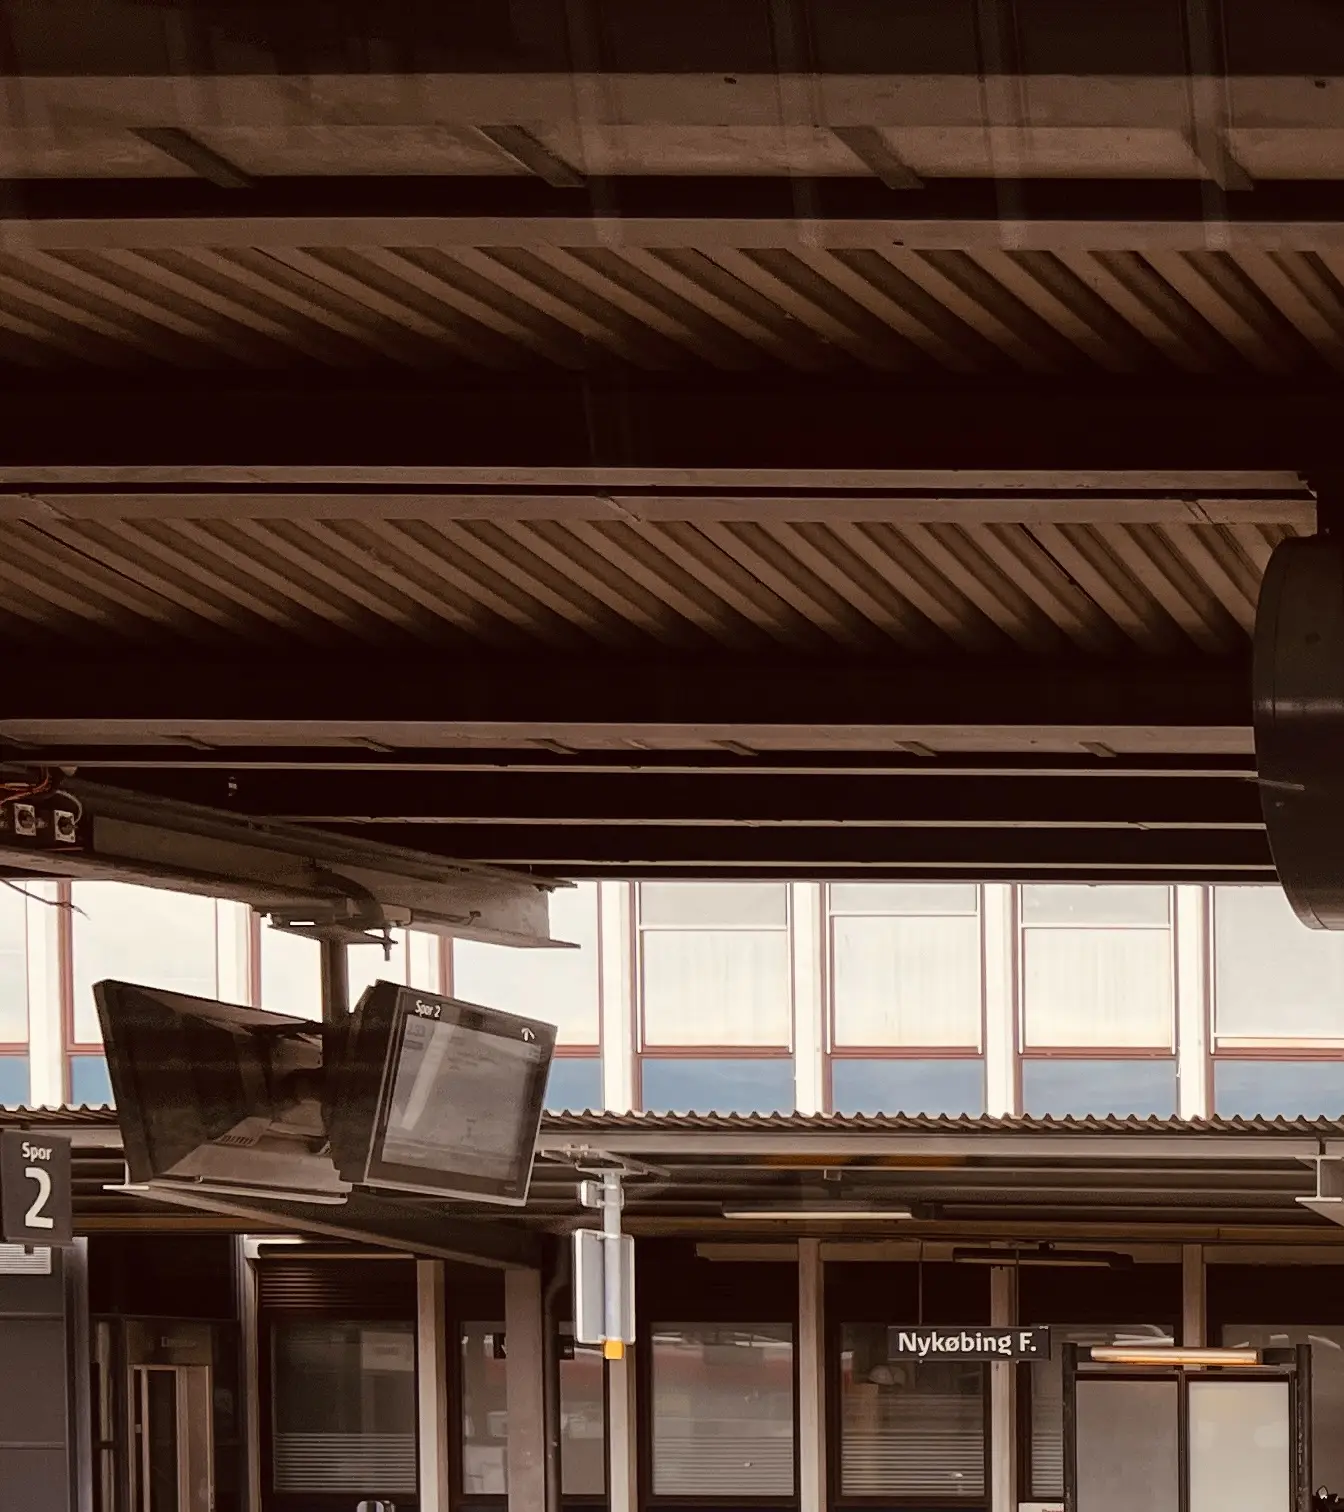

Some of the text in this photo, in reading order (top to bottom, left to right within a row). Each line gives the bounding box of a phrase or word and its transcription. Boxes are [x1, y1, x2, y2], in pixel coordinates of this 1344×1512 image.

[415, 1000, 441, 1017] Spor 2
[22, 1142, 52, 1162] Spor
[25, 1167, 53, 1228] 2
[898, 1331, 1037, 1356] Nykøbing F.
